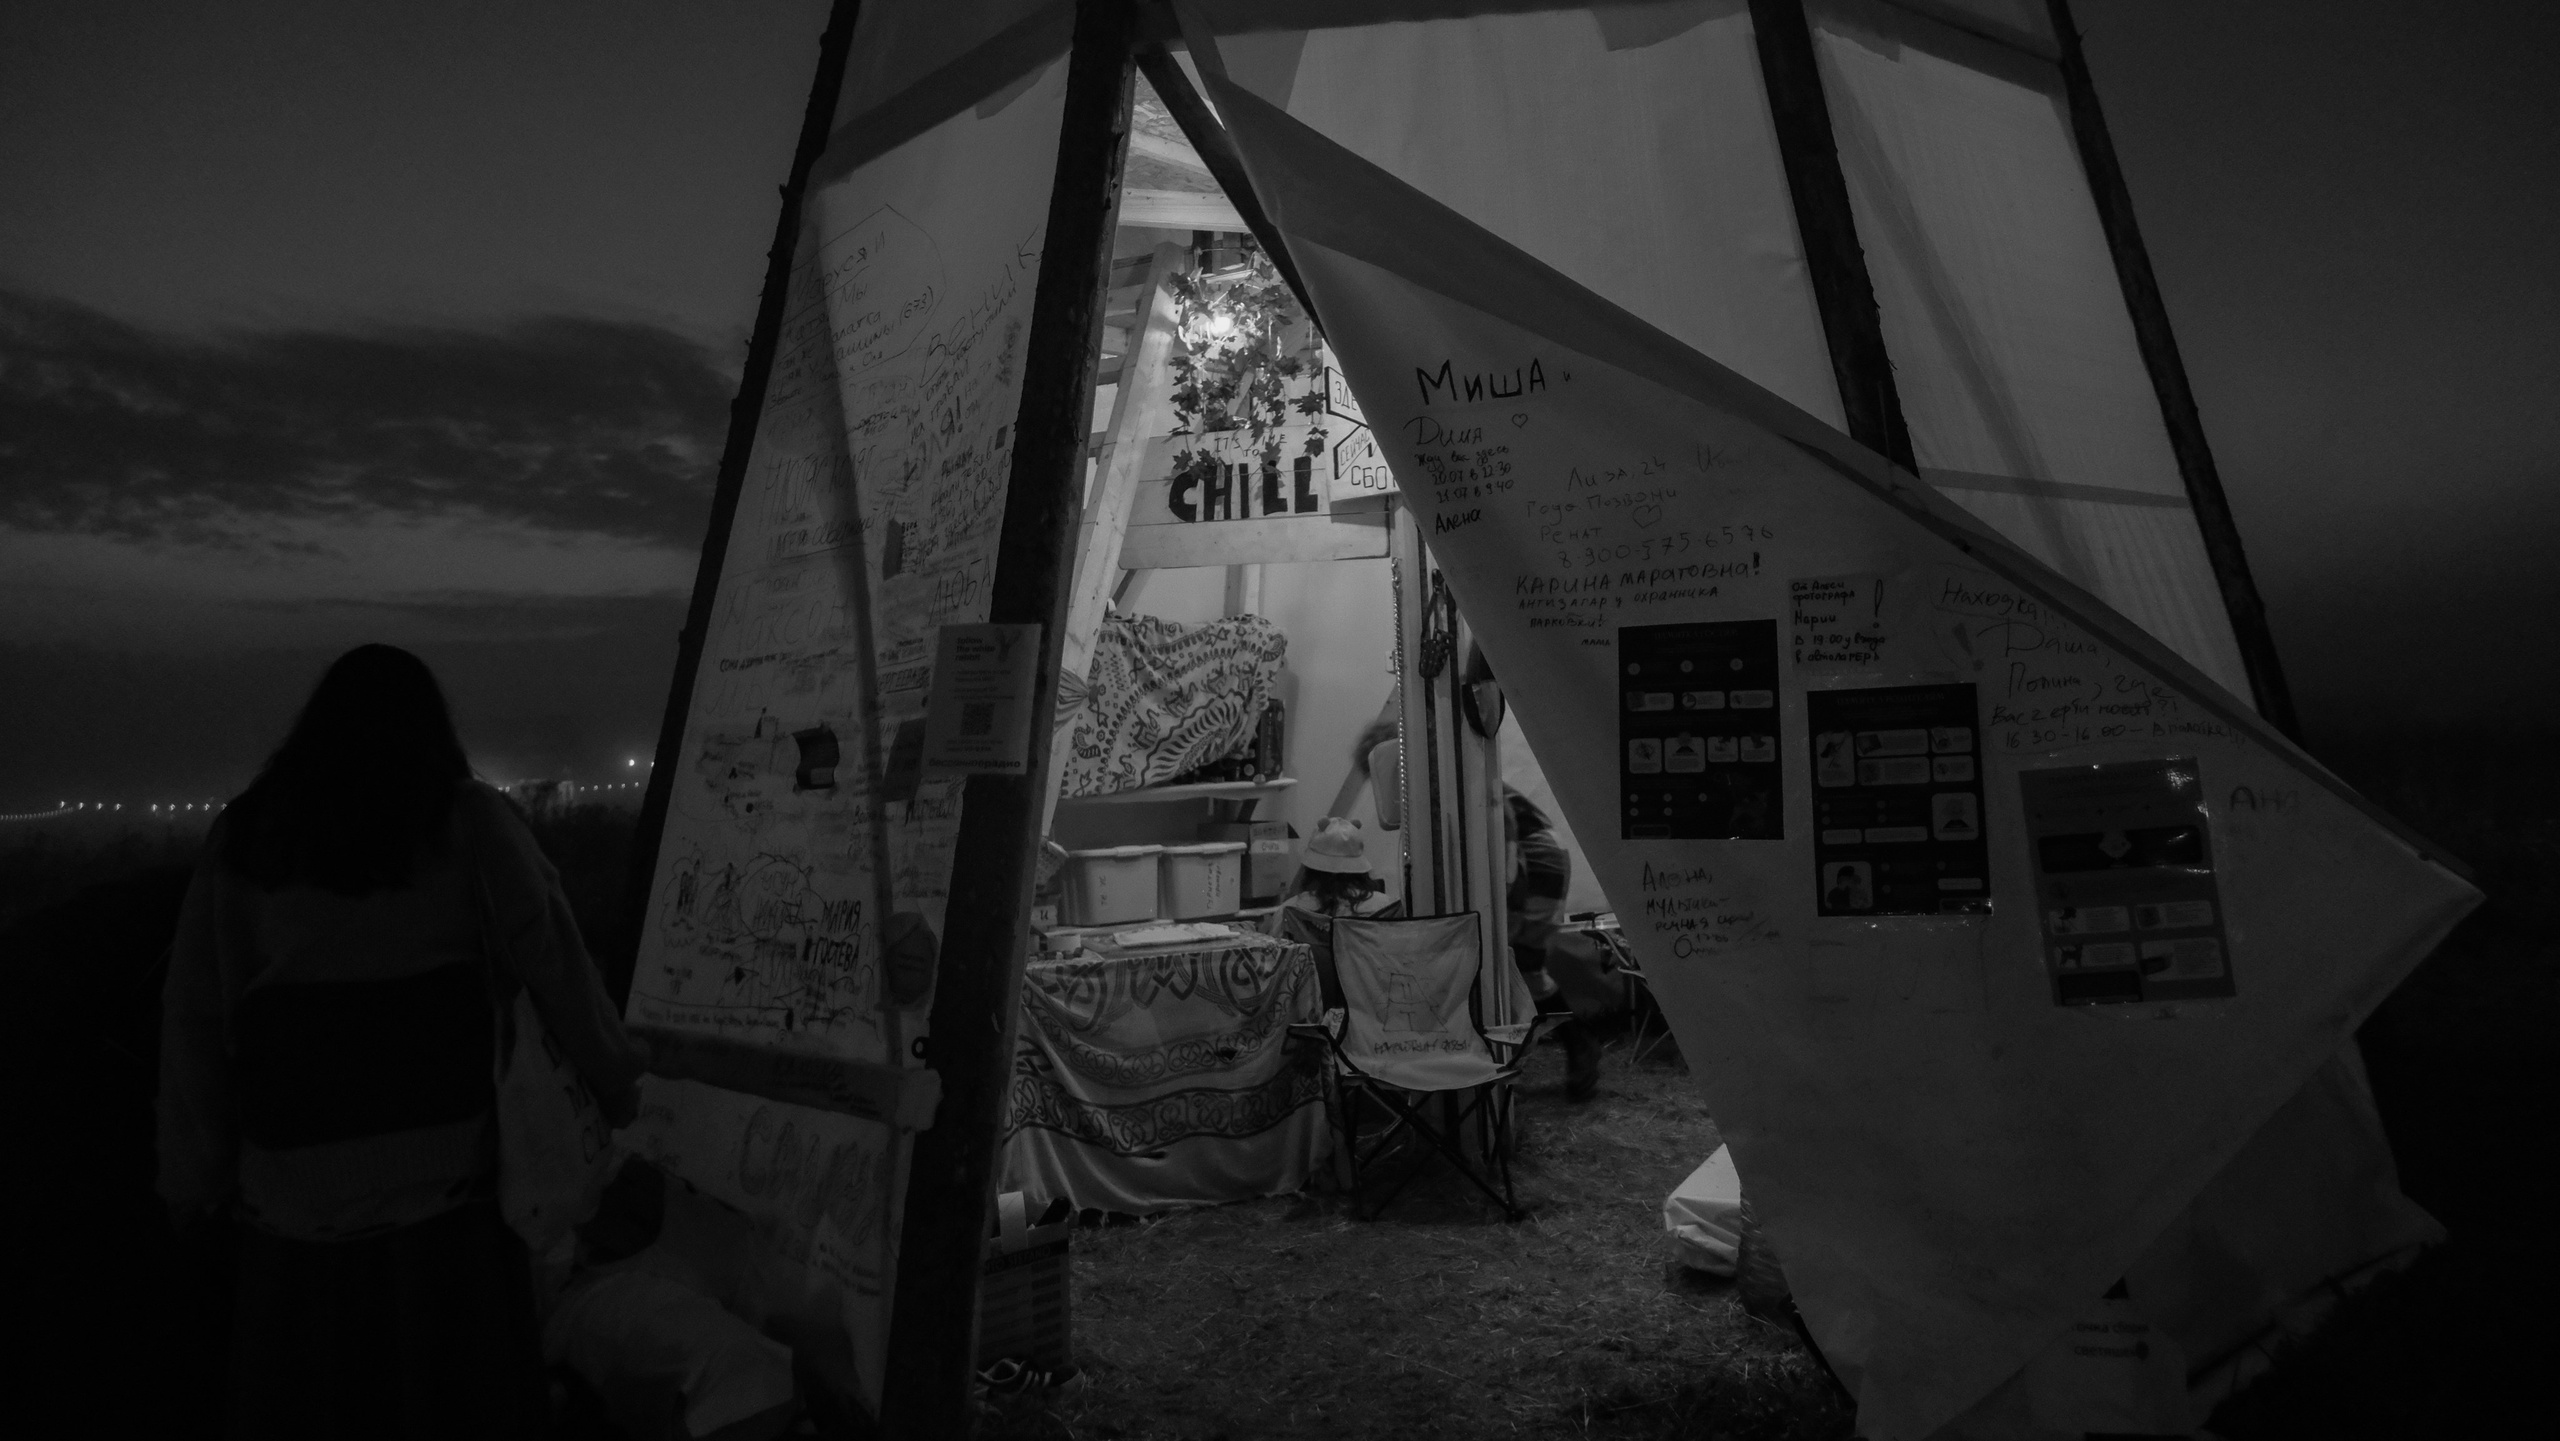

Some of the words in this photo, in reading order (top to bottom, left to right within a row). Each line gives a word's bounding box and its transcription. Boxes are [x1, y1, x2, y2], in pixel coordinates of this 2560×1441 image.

[1640, 455, 1666, 477] 24
[1168, 455, 1318, 524] CHILL
[1516, 573, 1611, 595] КАРИНА
